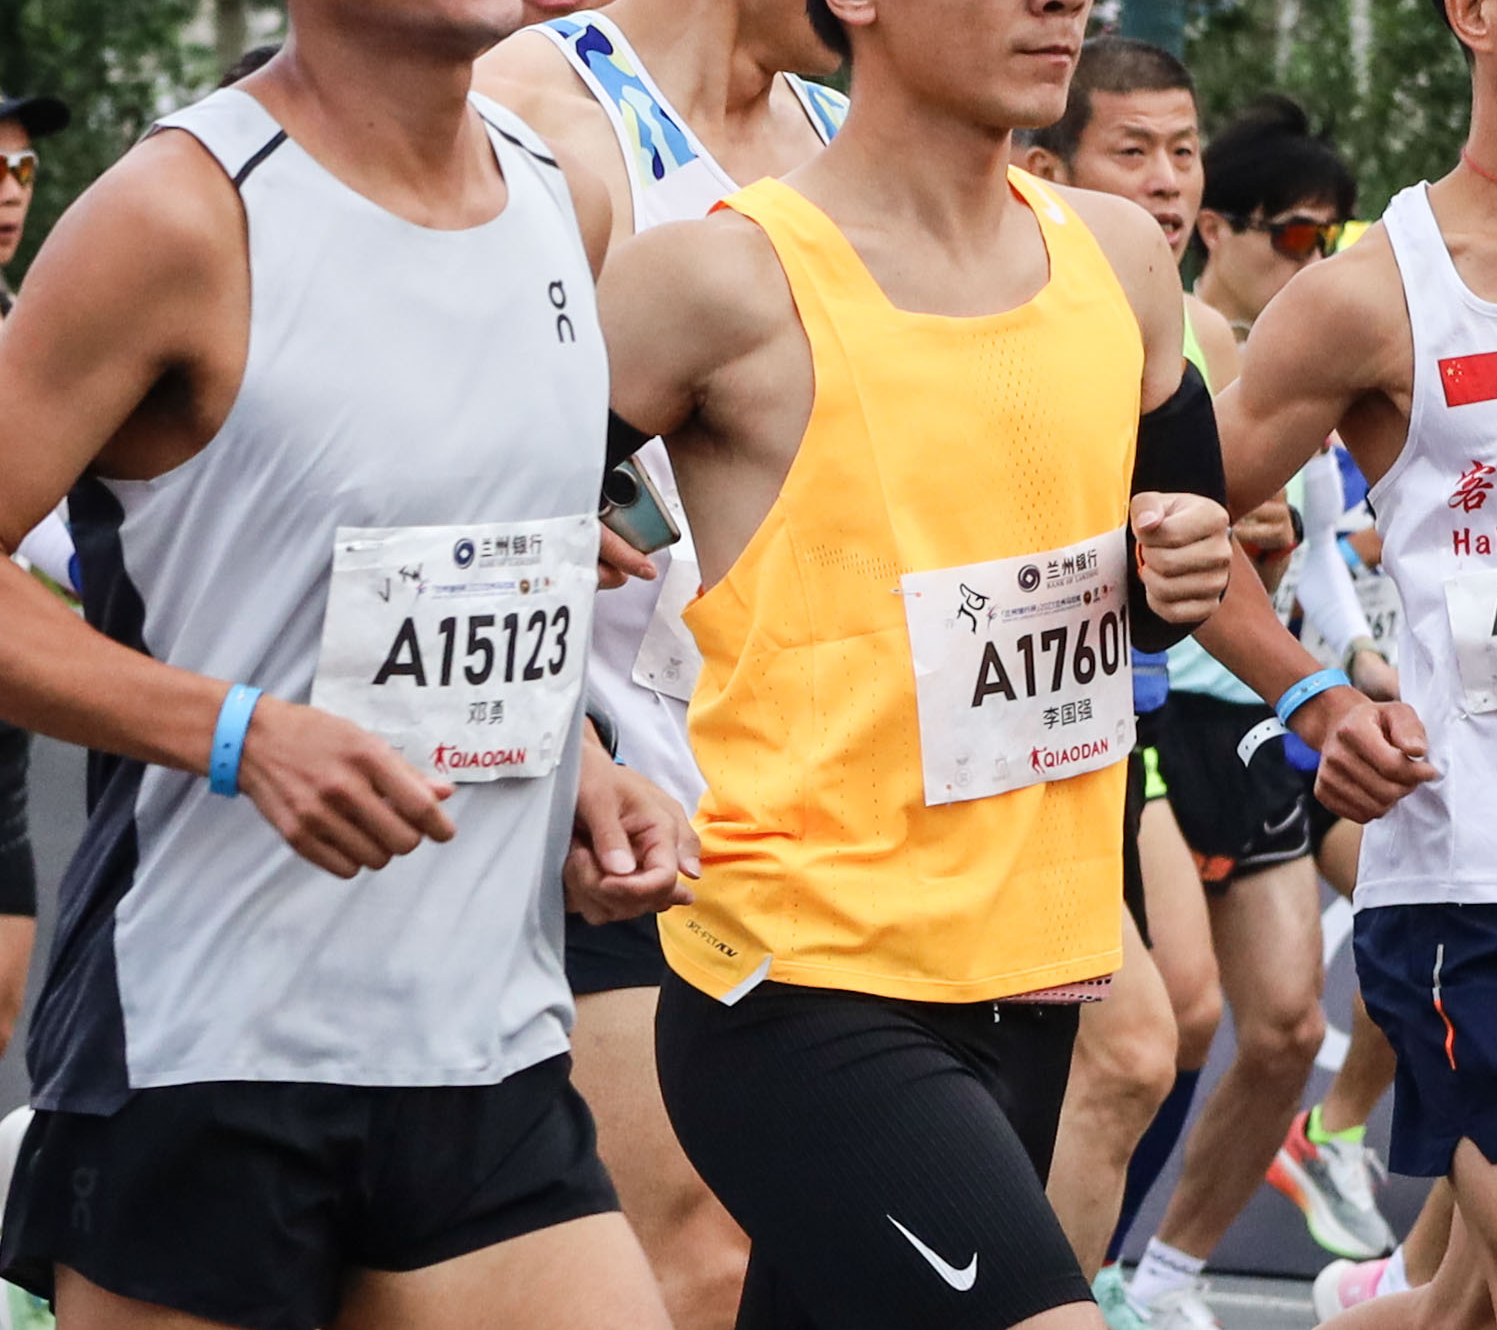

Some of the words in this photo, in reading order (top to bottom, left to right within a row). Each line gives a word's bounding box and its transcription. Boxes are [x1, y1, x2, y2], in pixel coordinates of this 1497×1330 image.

[479, 533, 543, 558] 兰州银行
[1046, 548, 1098, 581] 兰州银行
[371, 605, 571, 687] A15123
[971, 604, 1129, 709] A17601
[466, 699, 505, 725] 邓勇
[1043, 698, 1093, 730] 李国强
[448, 747, 527, 768] QIAODAN
[1044, 737, 1109, 768] QIAODAN
